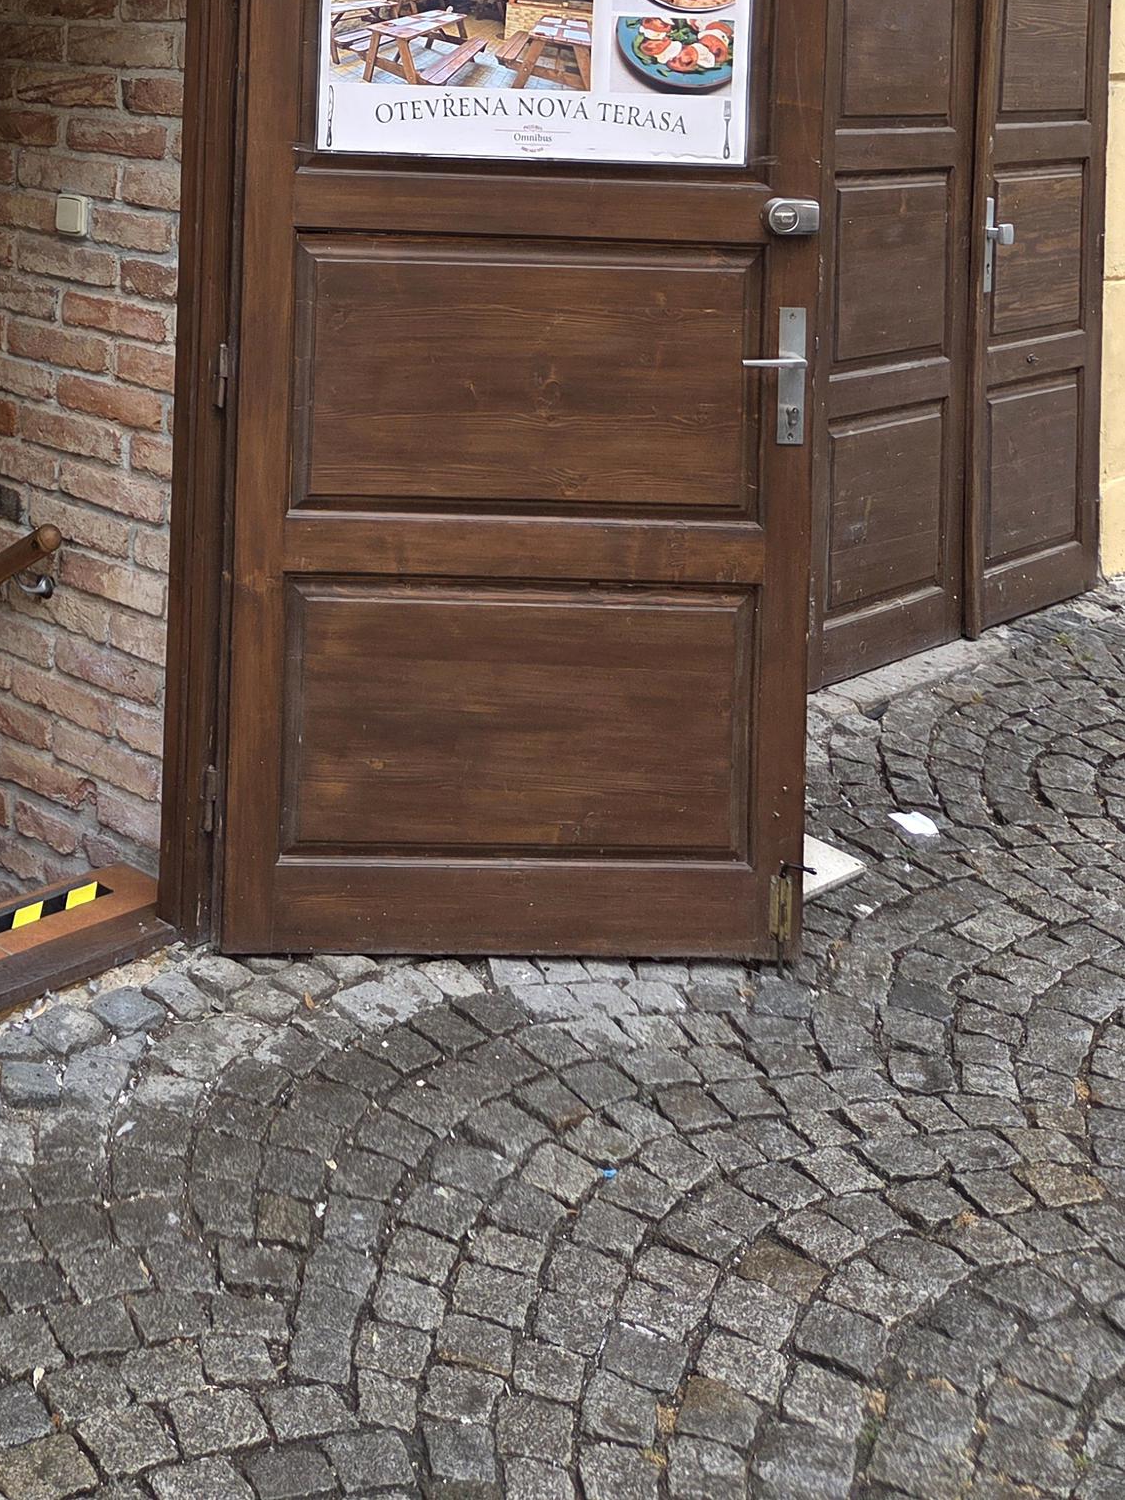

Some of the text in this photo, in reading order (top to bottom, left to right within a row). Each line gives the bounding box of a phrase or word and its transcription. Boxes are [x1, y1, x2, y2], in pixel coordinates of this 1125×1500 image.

[374, 92, 687, 136] OTEVŘENA NOVÁ TERASA
[513, 132, 553, 143] Omnibus
